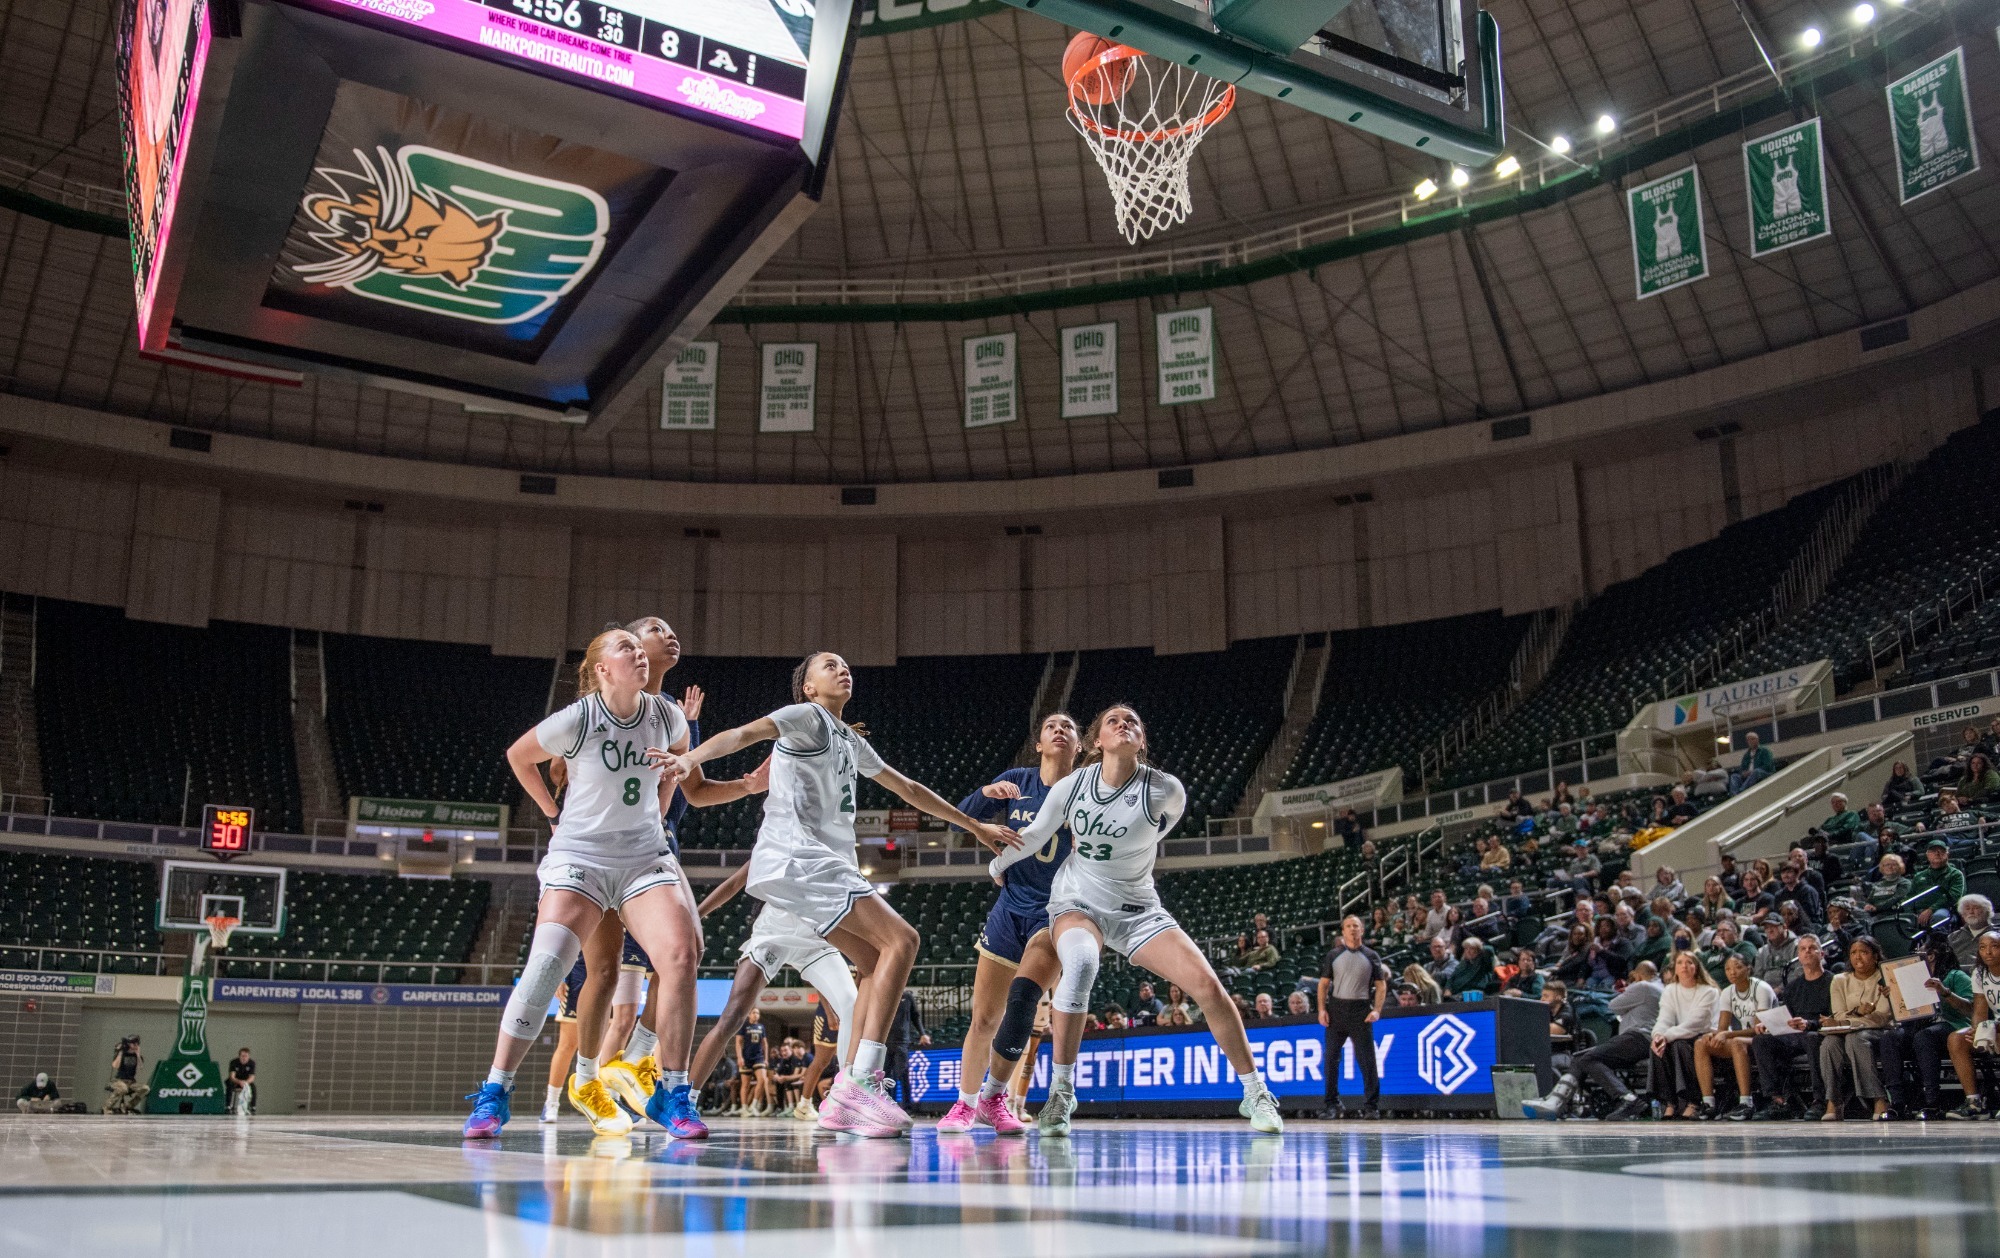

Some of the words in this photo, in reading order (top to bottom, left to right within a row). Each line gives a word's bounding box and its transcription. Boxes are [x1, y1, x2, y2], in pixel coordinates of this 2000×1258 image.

[599, 6, 623, 27] 1st
[489, 11, 516, 28] WHERE
[518, 20, 538, 35] YOUR
[541, 26, 556, 39] CAR
[558, 31, 588, 50] DREAMS
[591, 43, 611, 57] COME
[614, 50, 633, 64] TRUE
[597, 25, 624, 44] :30
[660, 30, 679, 58] 8
[480, 26, 634, 87] MARKPORTERAUTO.COM
[1903, 63, 1948, 96] DANIELS
[1761, 131, 1803, 154] HOUSKA
[1907, 152, 1968, 185] CHAMPION
[1908, 147, 1966, 176] NATIONAL
[1642, 177, 1684, 203] BLOSSER
[1758, 216, 1820, 240] CHAMPION
[1760, 210, 1817, 232] NATIONAL
[1643, 257, 1700, 283] CHAMPION
[1644, 253, 1697, 275] NATIONAL
[1170, 316, 1200, 336] OHIO
[976, 342, 1004, 360] OHIO
[1074, 332, 1104, 351] OHIO
[775, 350, 804, 366] OHIO
[1165, 371, 1194, 382] SWEET
[1172, 384, 1201, 397] 2005
[1705, 672, 1799, 708] LAURELS
[1914, 705, 1980, 727] RESERVED
[602, 740, 659, 772] Ohi
[622, 777, 641, 806] 8
[217, 811, 248, 826] 4:56
[378, 806, 426, 818] Holzer
[452, 809, 498, 822] Holzer
[1074, 809, 1128, 838] Ohio
[212, 824, 242, 848] 30
[1078, 842, 1113, 861] 23
[17, 974, 66, 983] 593-6779
[303, 988, 338, 999] LOCAL
[403, 990, 500, 1002] CARPENTERS.COM
[1074, 1047, 1175, 1088] ETTER
[1184, 1034, 1394, 1085] INTEGRTY
[159, 1087, 214, 1098] gomart
